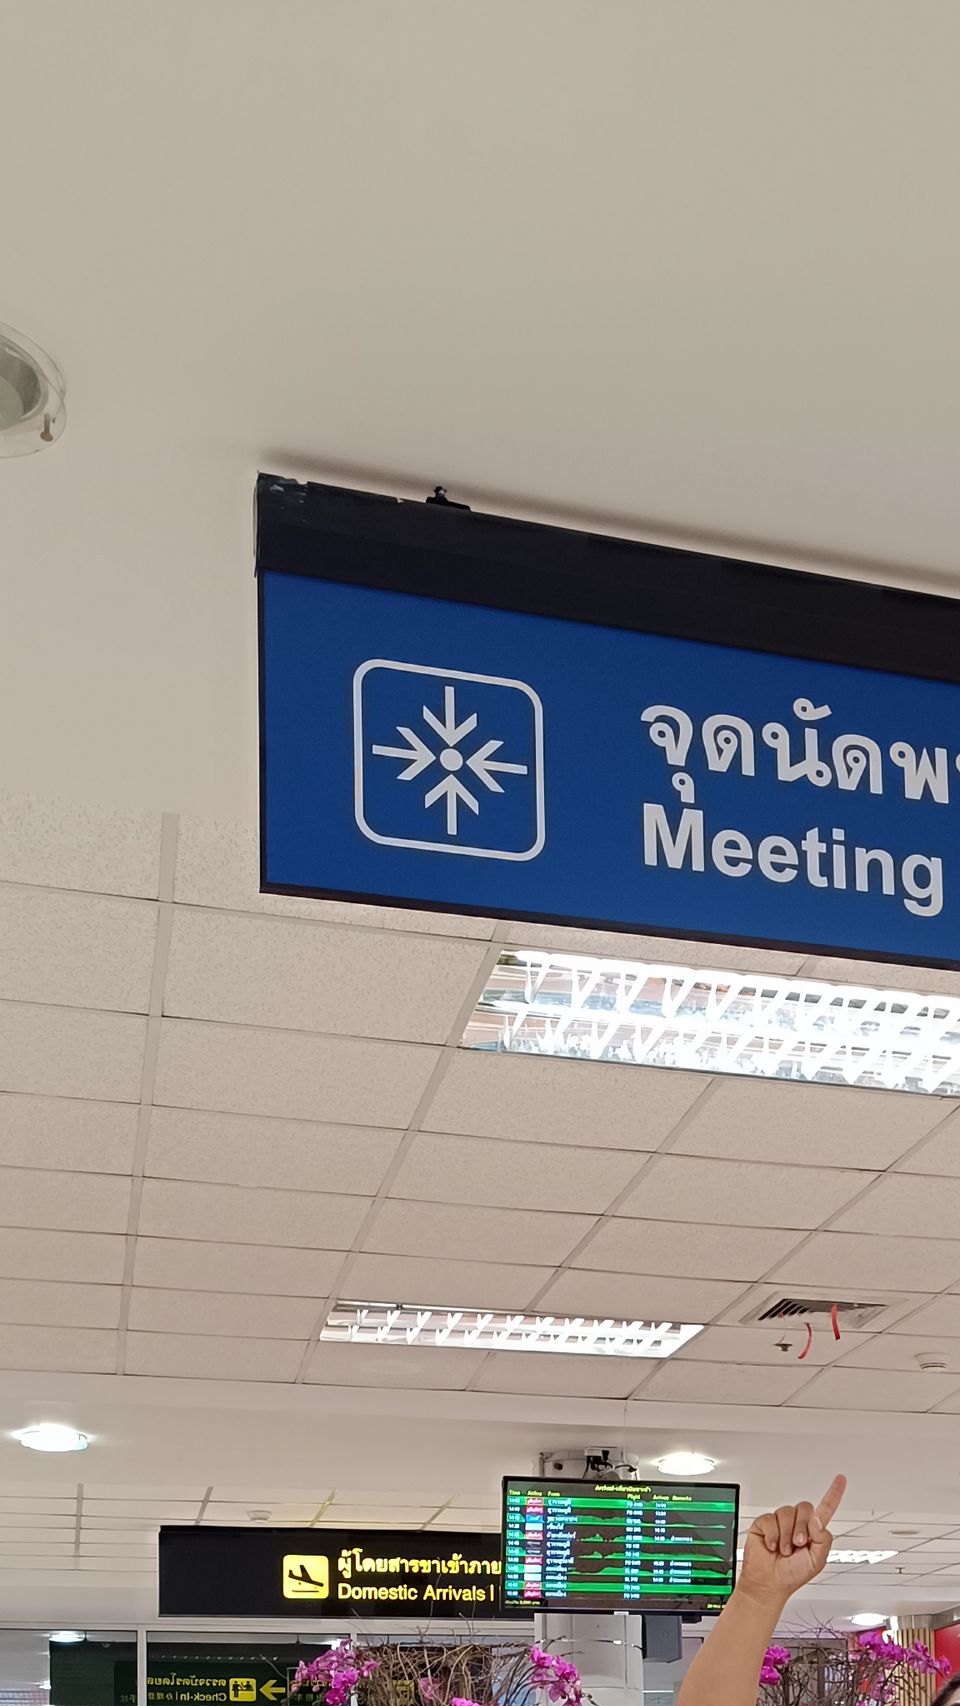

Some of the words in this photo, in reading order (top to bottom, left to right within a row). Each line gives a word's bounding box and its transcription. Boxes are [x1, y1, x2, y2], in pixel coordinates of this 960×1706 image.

[643, 803, 944, 917] Meeting
[337, 1547, 502, 1578] ผู้โดยสารขาเข้าภาย
[337, 1583, 418, 1600] Domestic
[423, 1584, 486, 1601] Arrivals
